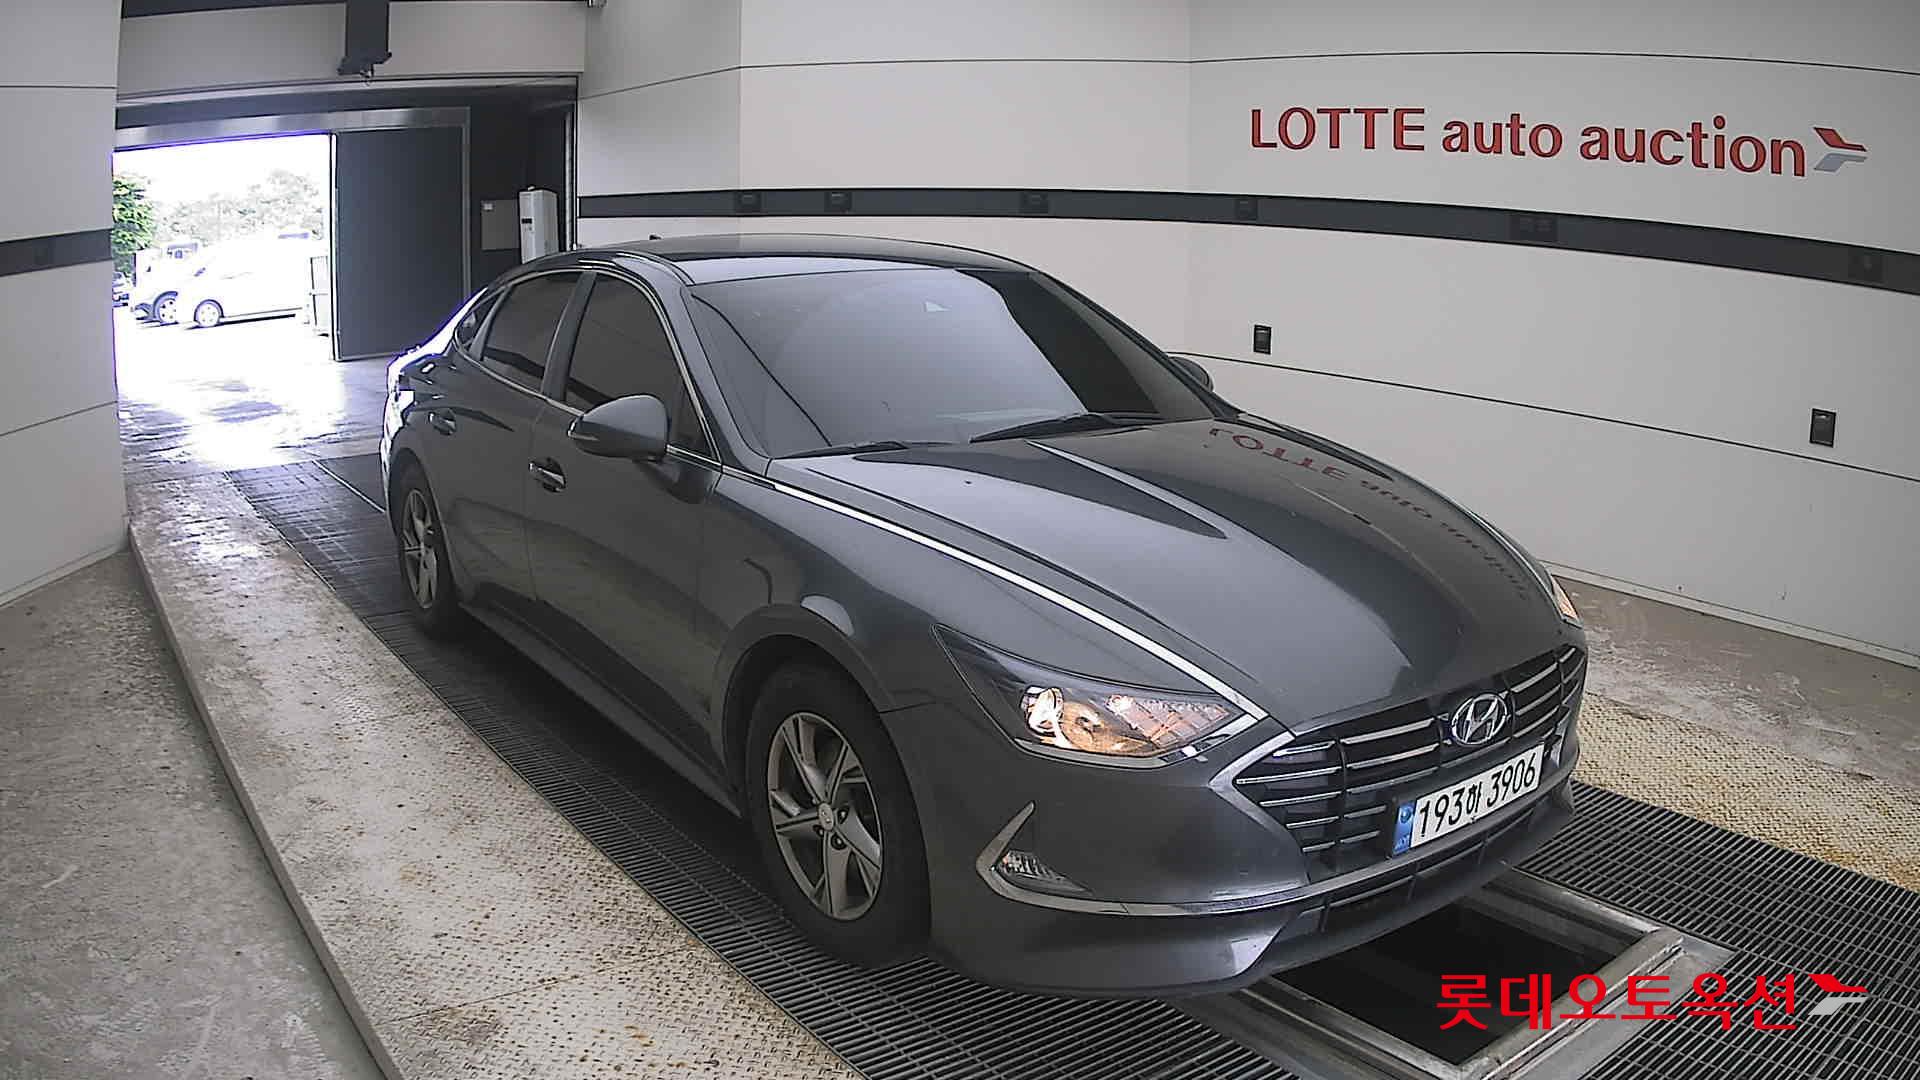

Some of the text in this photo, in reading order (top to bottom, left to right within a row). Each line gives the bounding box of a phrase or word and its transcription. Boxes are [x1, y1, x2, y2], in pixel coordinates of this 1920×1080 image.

[1251, 107, 1807, 178] LOTTE auto auction
[1420, 752, 1536, 838] 193하 3906
